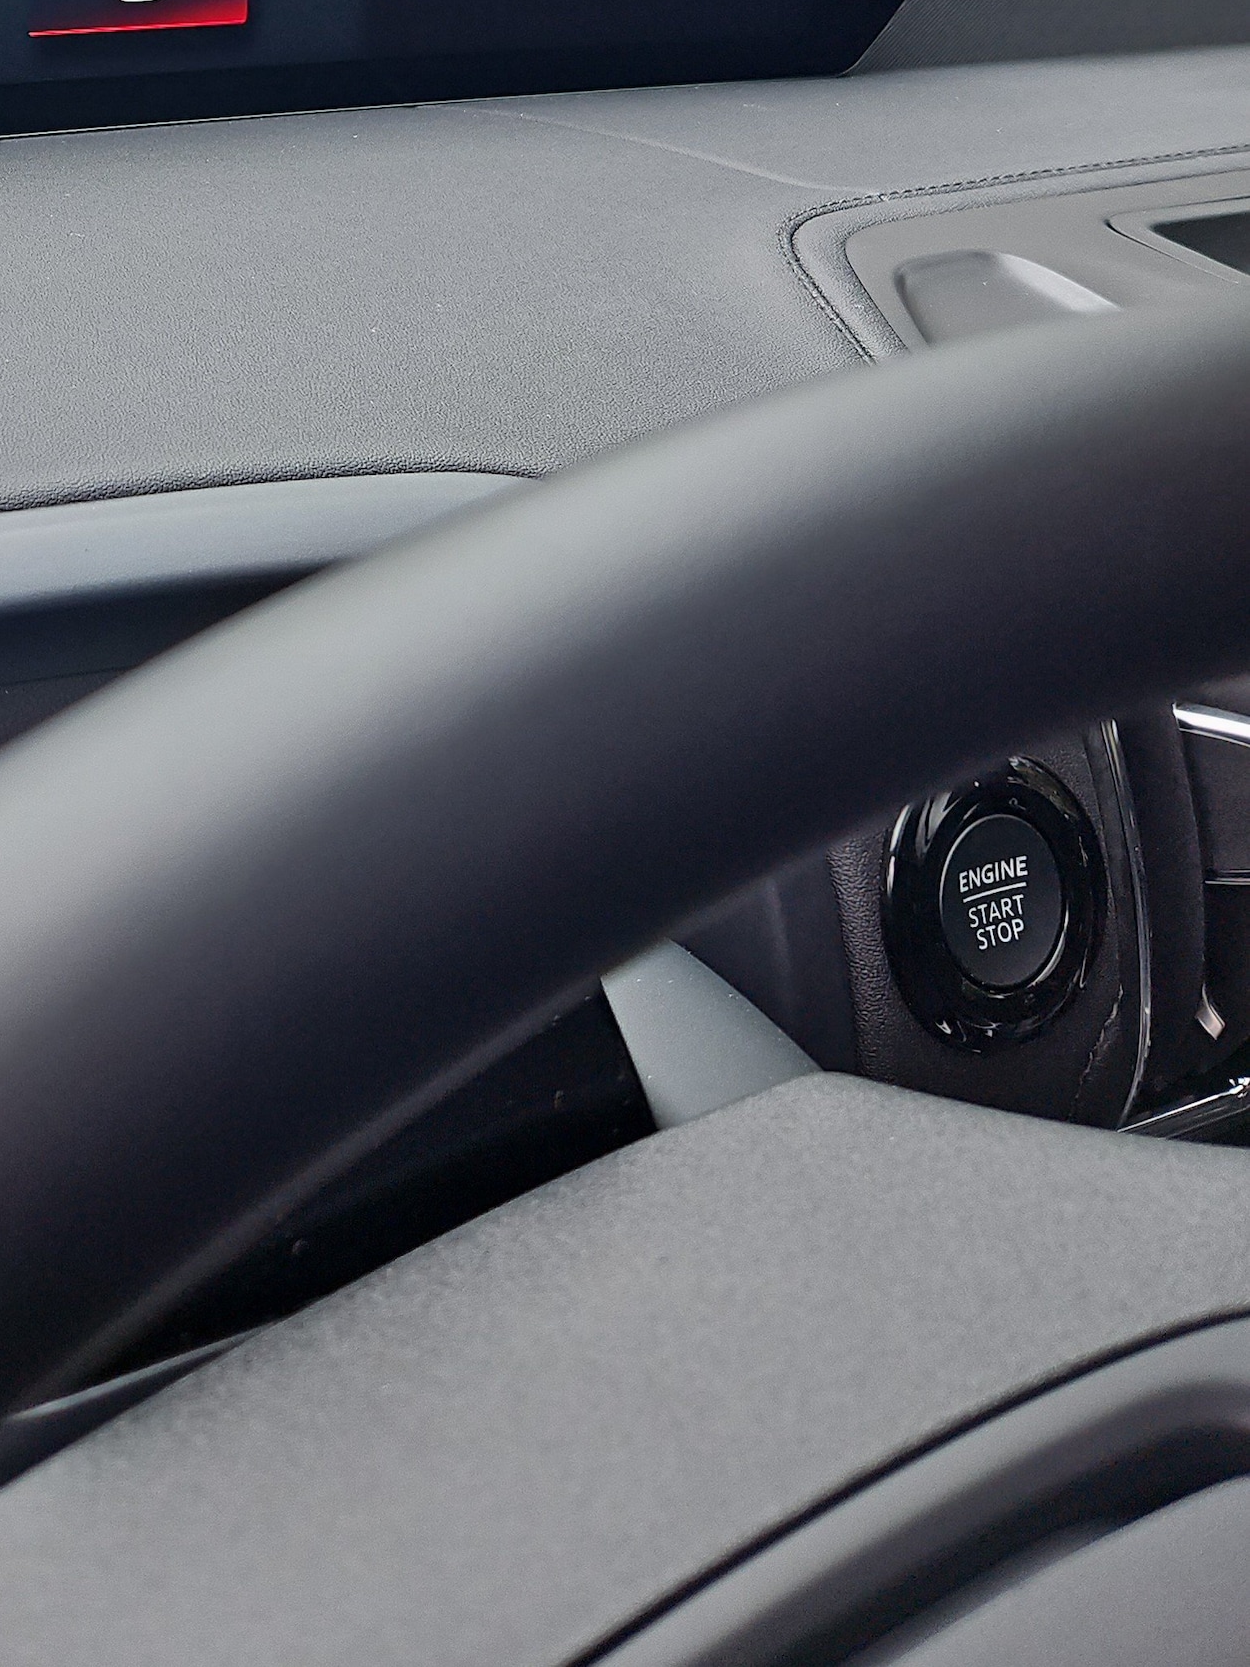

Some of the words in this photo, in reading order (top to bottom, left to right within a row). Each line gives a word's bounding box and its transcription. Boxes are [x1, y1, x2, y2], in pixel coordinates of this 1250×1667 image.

[959, 856, 1028, 893] ENGINE
[968, 894, 1024, 928] START
[976, 918, 1025, 950] STOP
